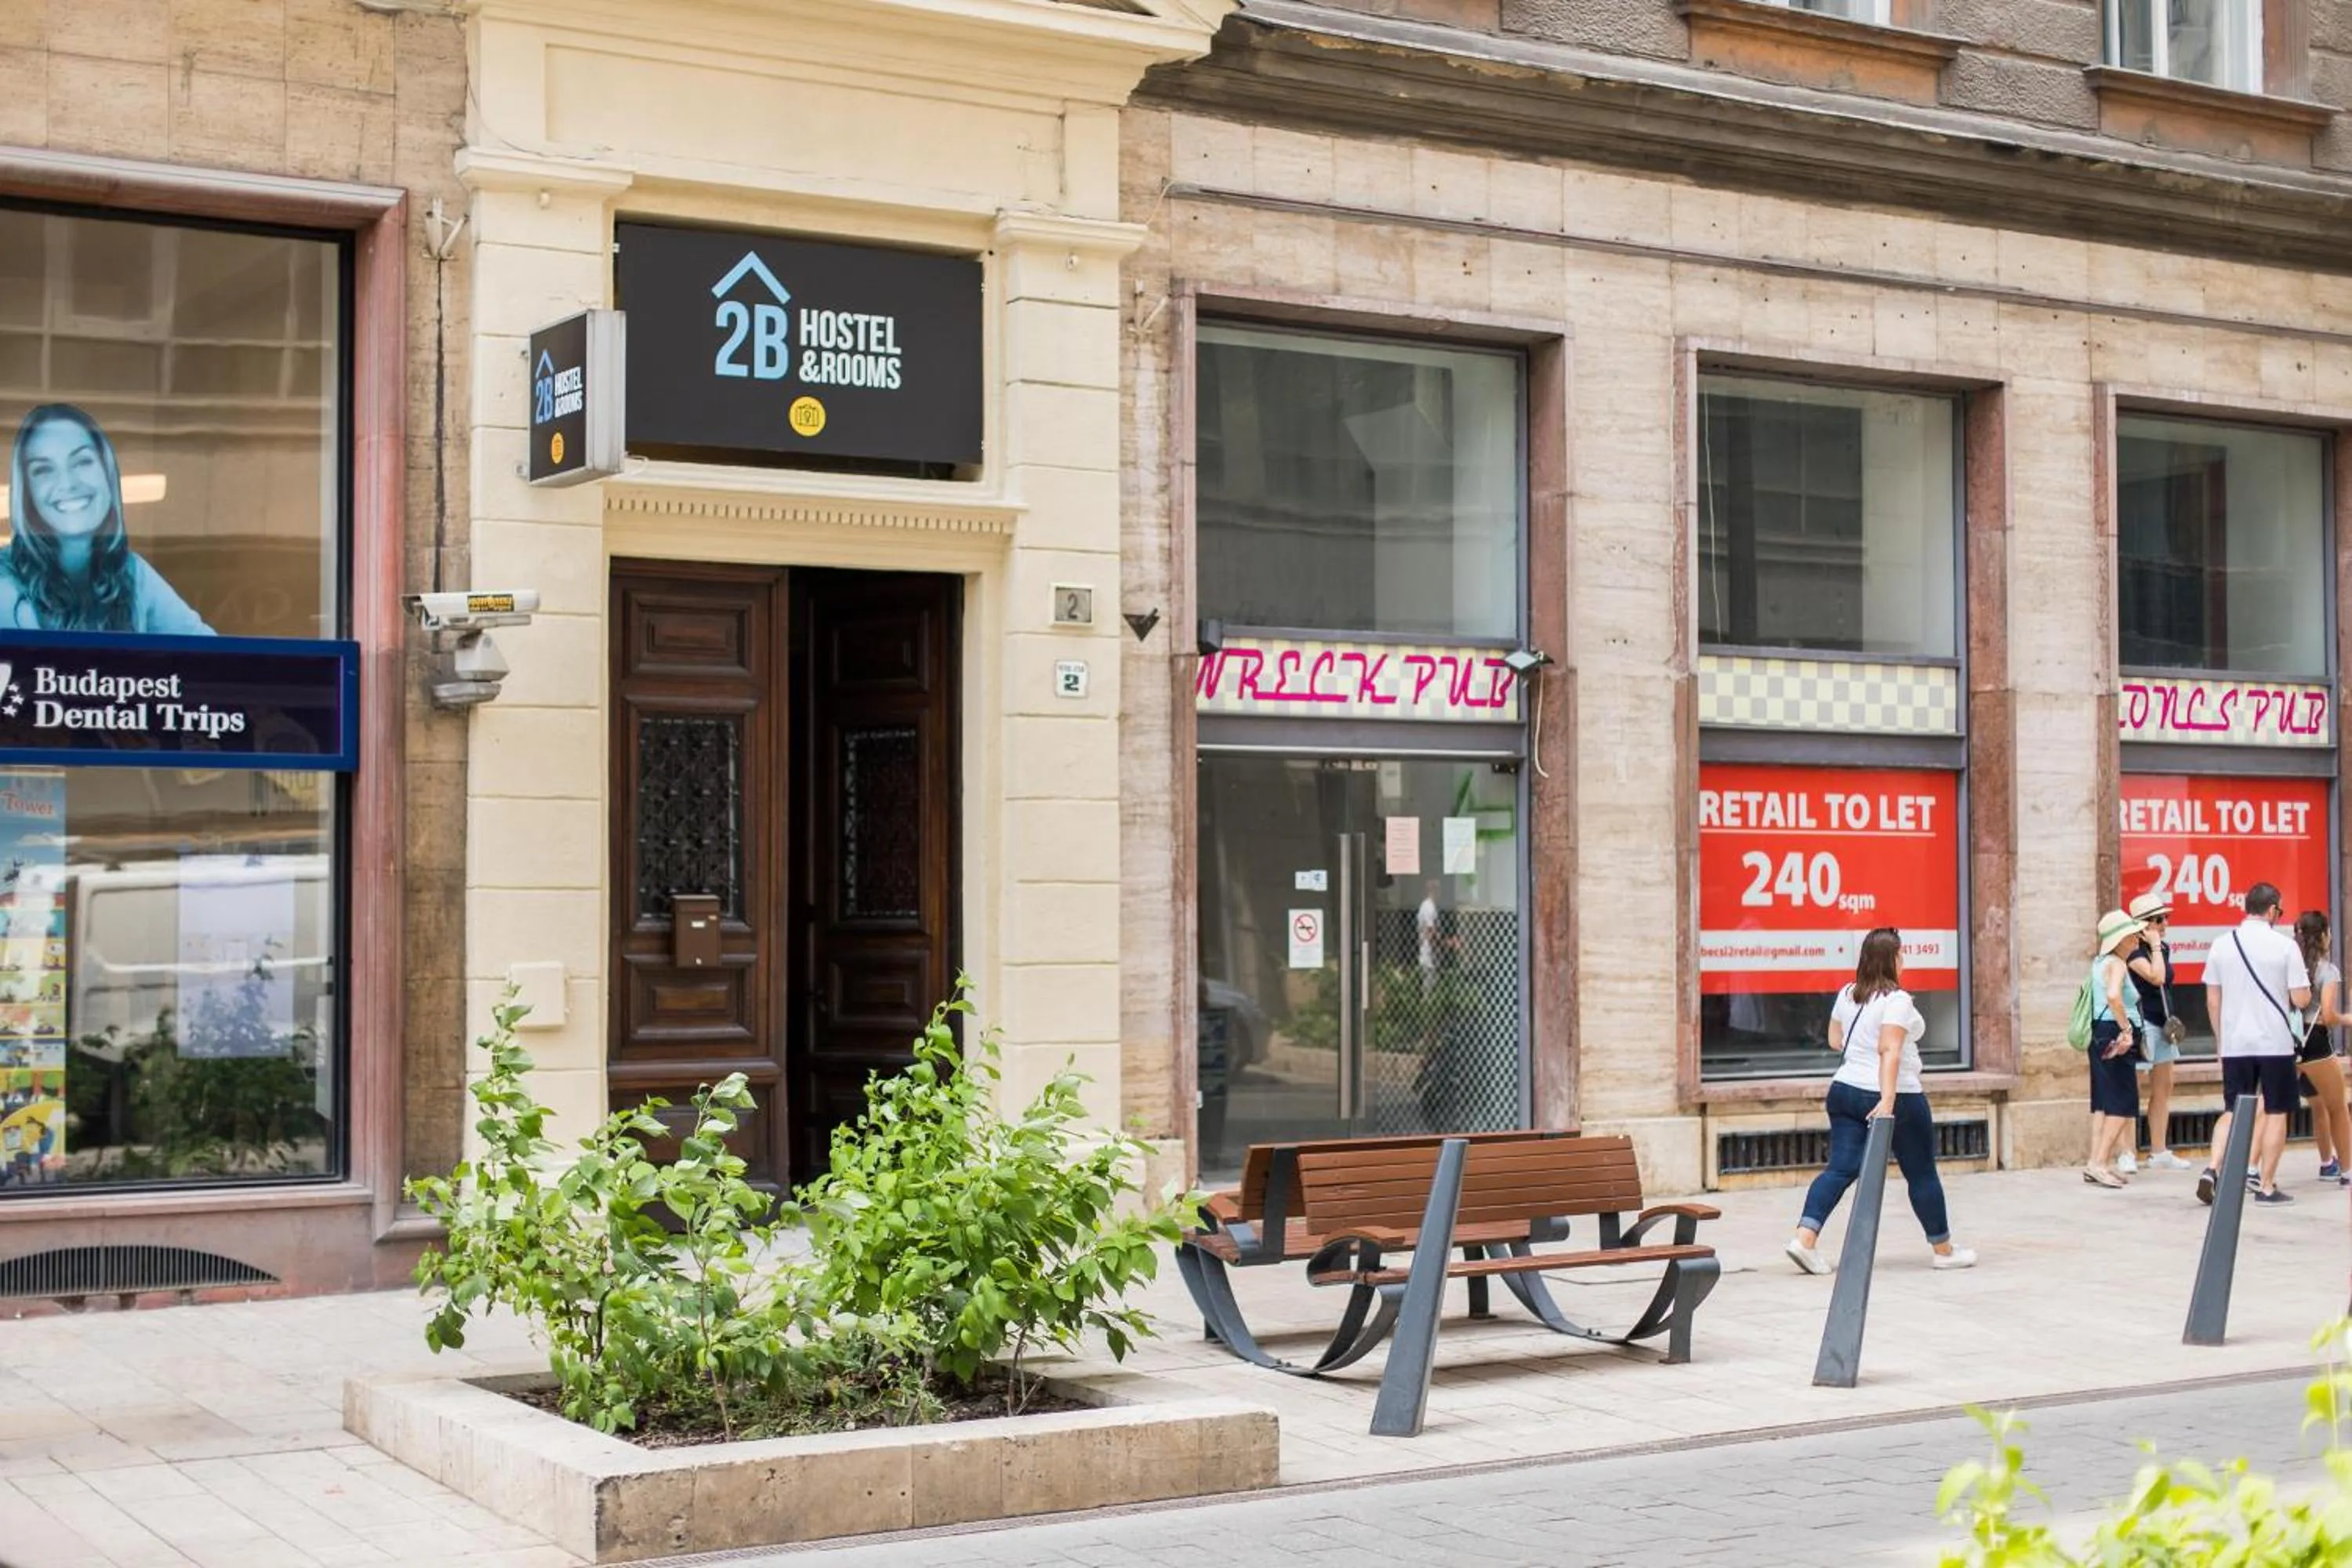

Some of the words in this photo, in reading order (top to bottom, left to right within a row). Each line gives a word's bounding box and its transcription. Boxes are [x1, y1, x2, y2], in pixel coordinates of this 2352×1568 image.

[714, 299, 789, 380] 2B
[799, 308, 902, 355] HOSTEL
[554, 366, 583, 397] HOSTEL
[798, 350, 902, 390] &ROOMS
[535, 375, 554, 425] 2B
[1067, 592, 1078, 619] 2
[34, 667, 182, 702] Budapest
[1063, 673, 1080, 691] 2
[1404, 655, 1515, 708] PUB
[33, 700, 149, 731] Dental
[157, 704, 246, 739] Trips
[2247, 689, 2326, 735] PUB
[1700, 789, 1817, 829] RETAIL
[1824, 793, 1871, 830] TO
[1879, 795, 1936, 831] LET
[2216, 800, 2256, 833] TO
[2262, 800, 2311, 834] LET
[1741, 851, 1842, 907] 240
[1838, 891, 1876, 915] sqm
[2147, 853, 2230, 906] 240
[2228, 892, 2248, 912] sq
